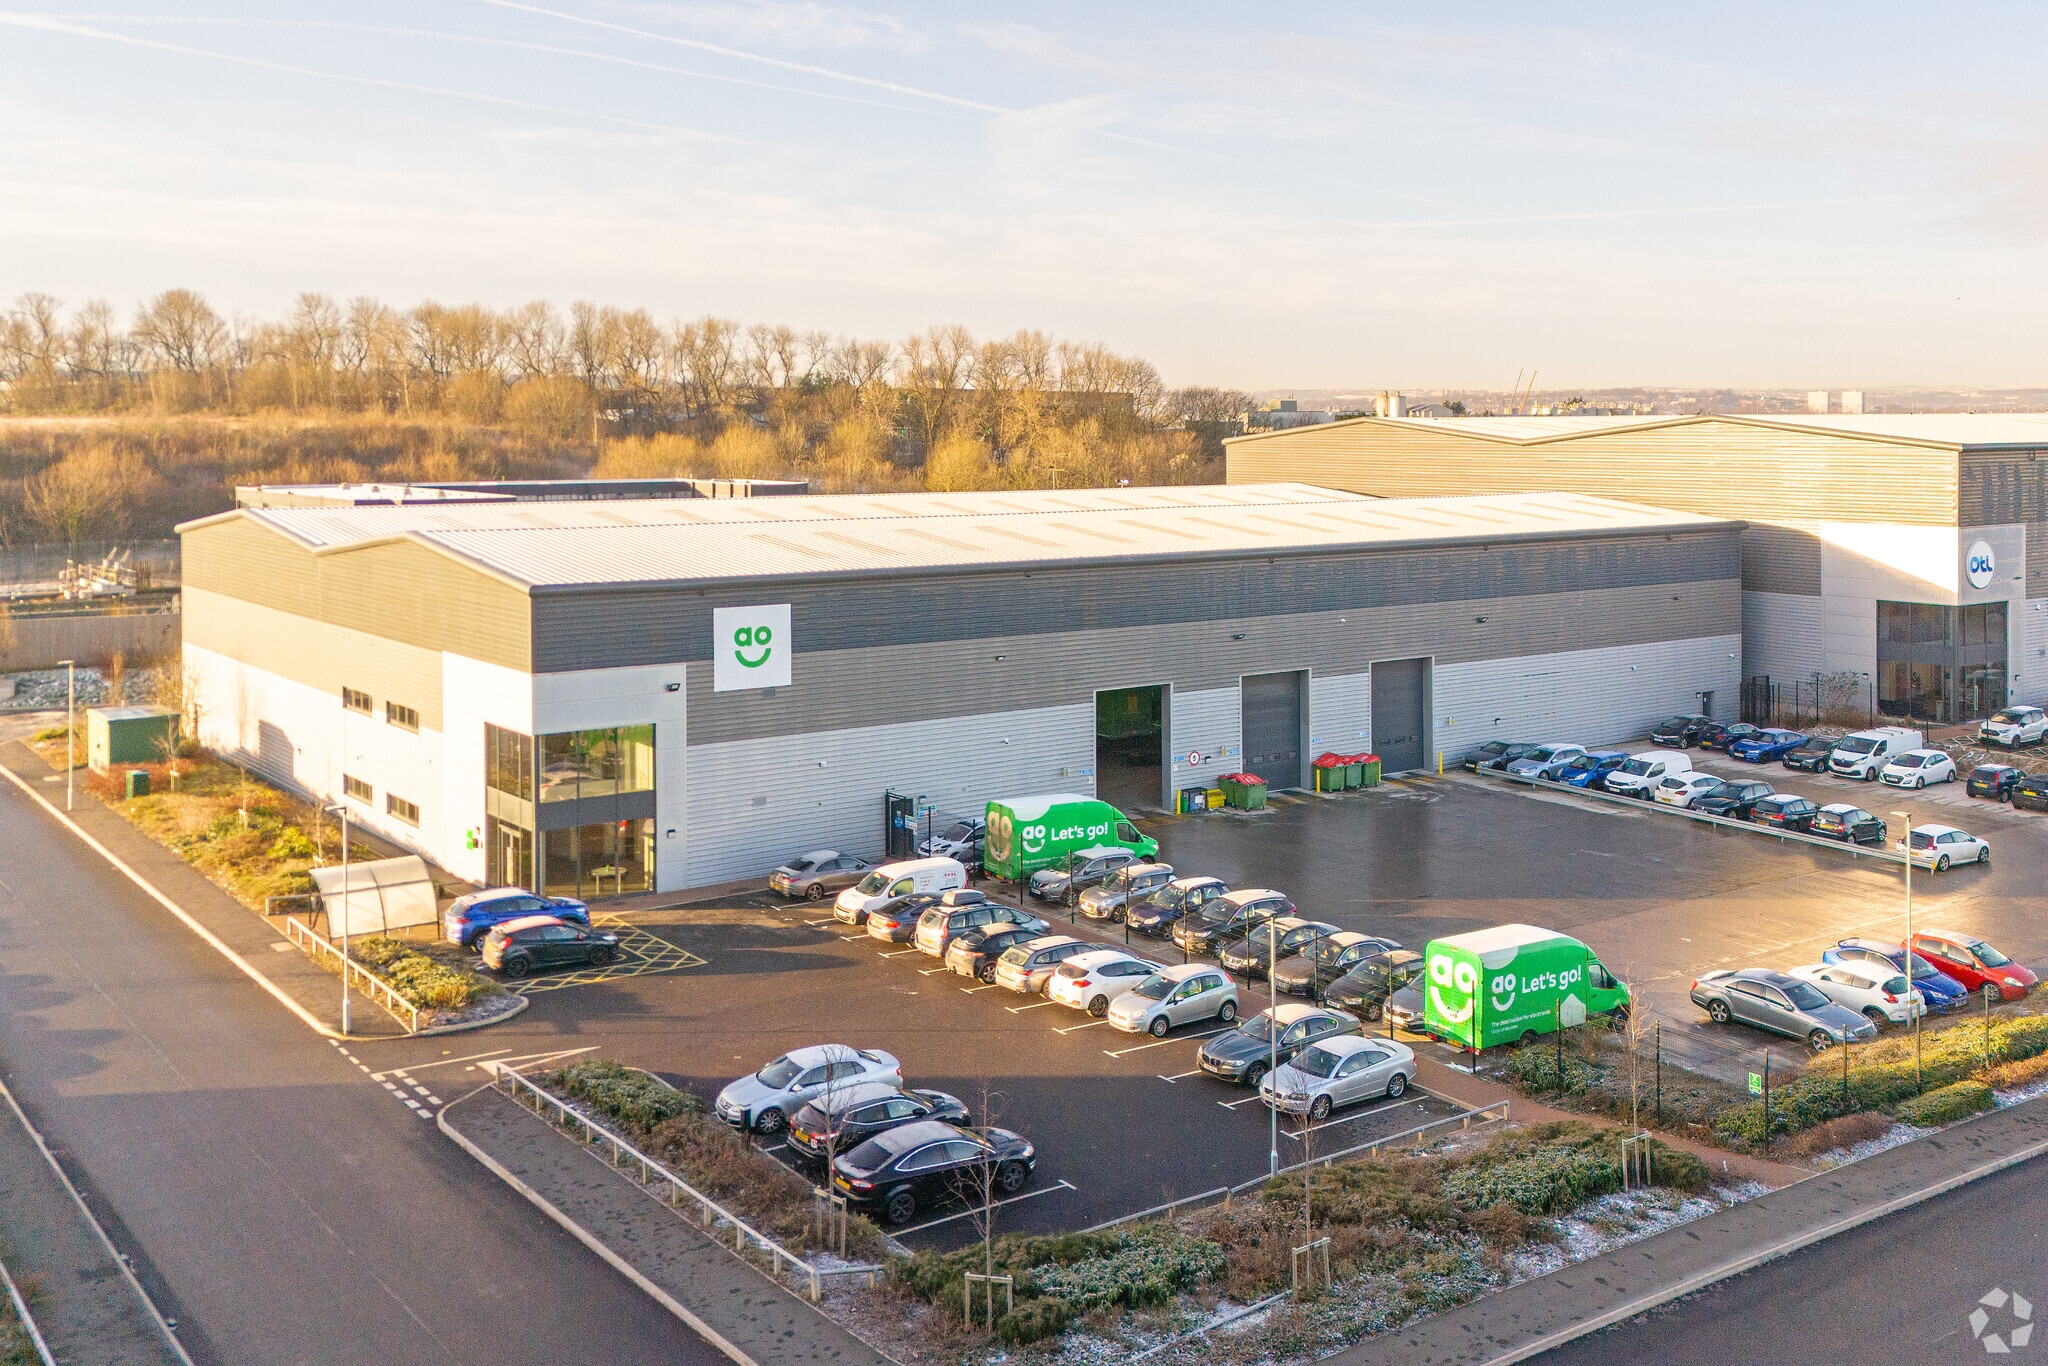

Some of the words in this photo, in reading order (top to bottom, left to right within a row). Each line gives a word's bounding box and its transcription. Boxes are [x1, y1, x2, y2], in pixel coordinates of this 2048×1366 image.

[734, 626, 772, 647] ao
[1022, 825, 1046, 840] ao
[1051, 825, 1084, 841] Let's
[1087, 822, 1108, 840] go!
[1429, 954, 1478, 993] ao
[1491, 973, 1516, 994] ao
[1522, 971, 1556, 994] Let's
[1559, 965, 1582, 990] go!
